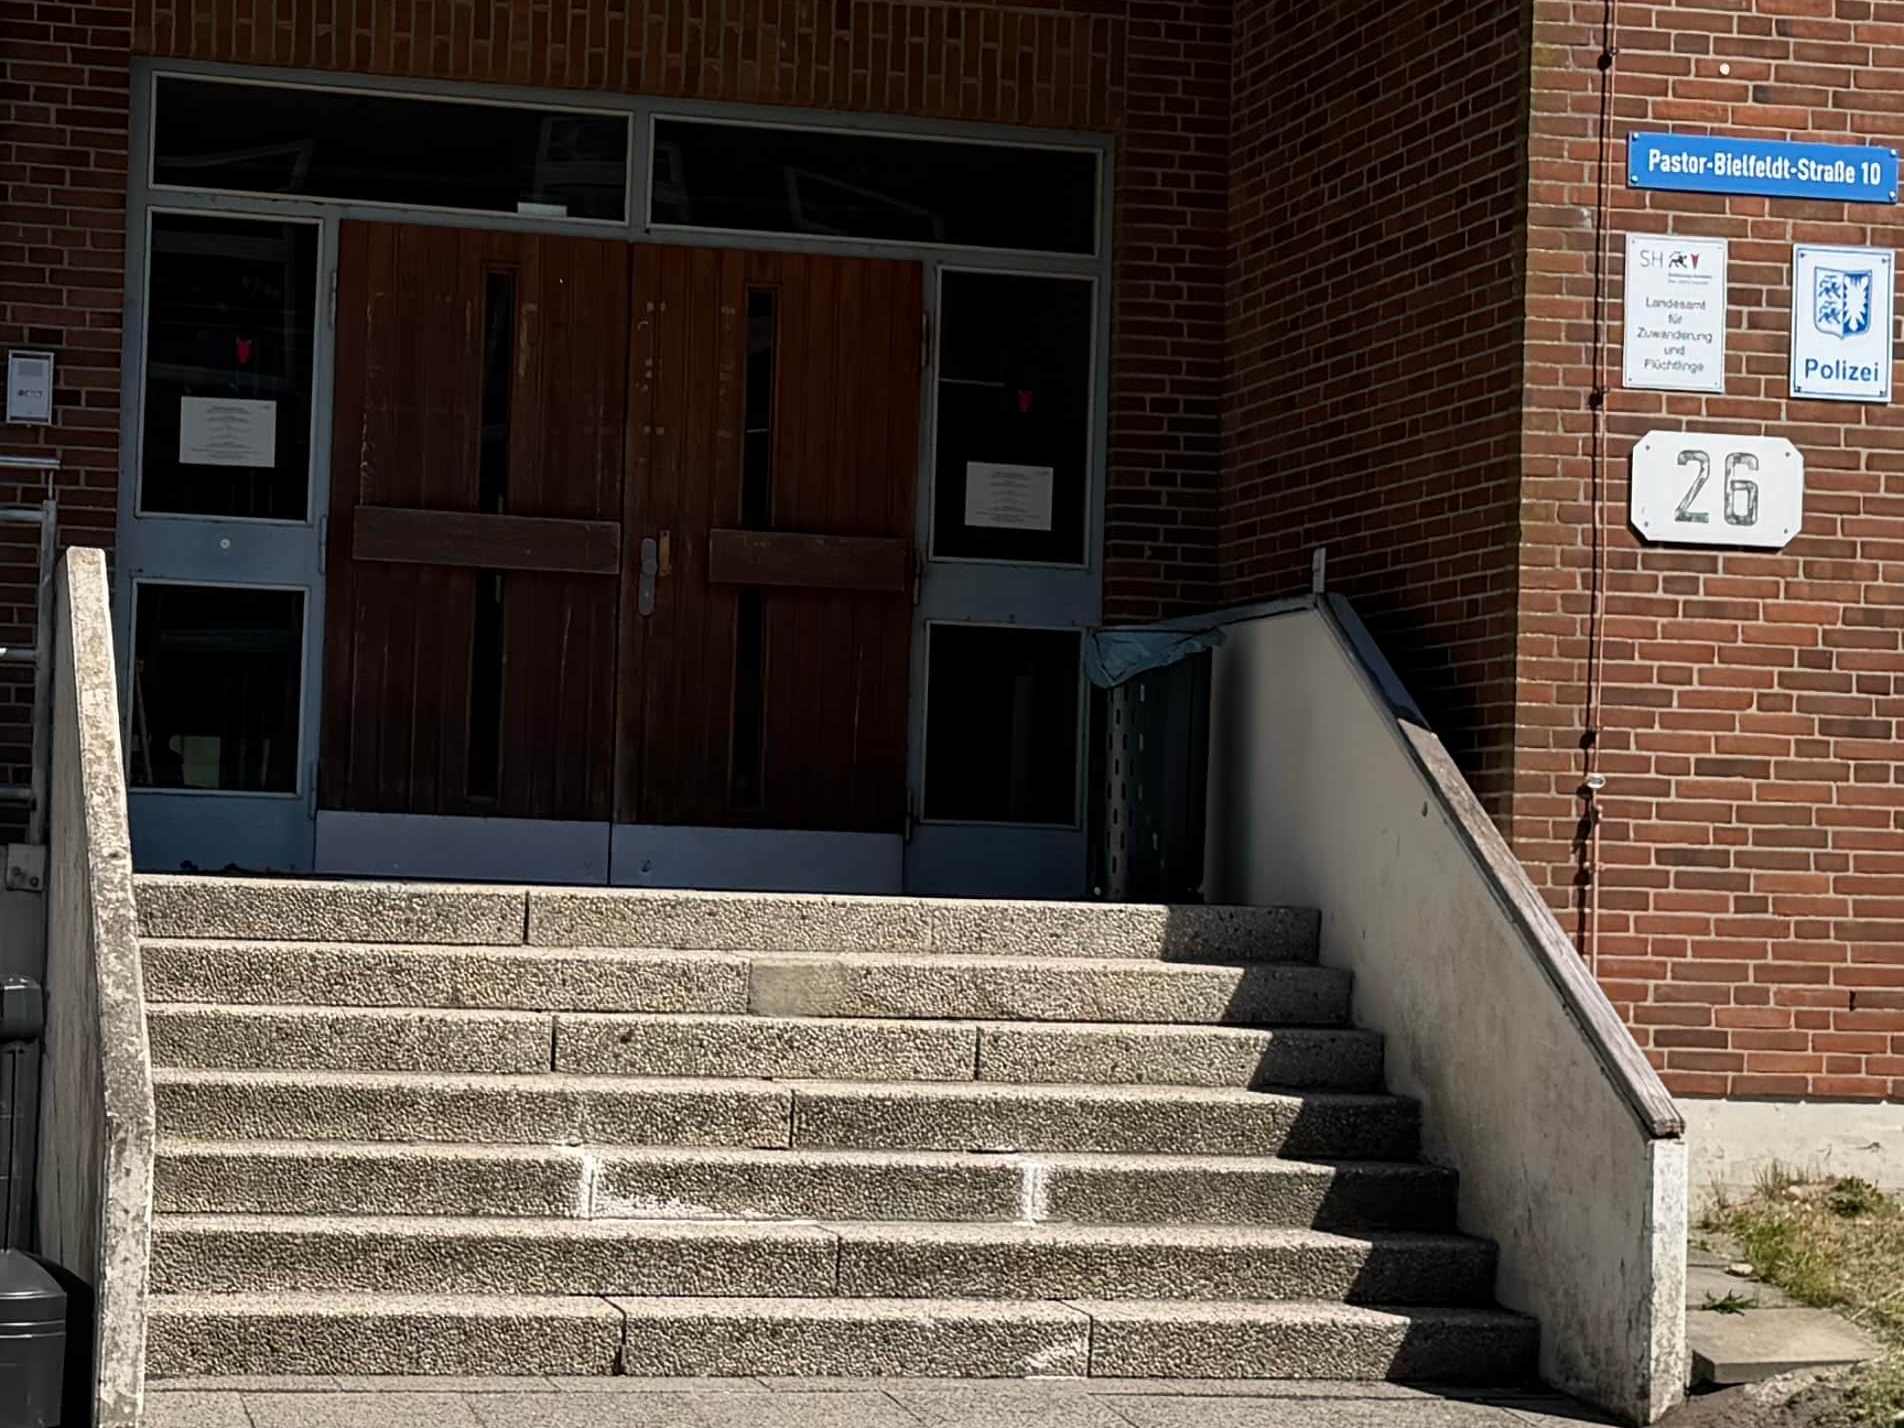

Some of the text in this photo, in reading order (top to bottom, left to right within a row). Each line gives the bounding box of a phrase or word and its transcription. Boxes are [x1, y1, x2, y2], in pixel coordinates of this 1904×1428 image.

[1648, 148, 1881, 186] Pastor-Bielfeldt-Straße 10
[1640, 249, 1664, 269] SH
[1645, 296, 1707, 311] Landesamt
[1668, 313, 1684, 325] für
[1637, 327, 1713, 344] Zuwanderung
[1664, 345, 1686, 357] und
[1643, 358, 1705, 375] Flüchtlinge
[1805, 358, 1879, 382] Polizei
[1674, 449, 1759, 527] 26
